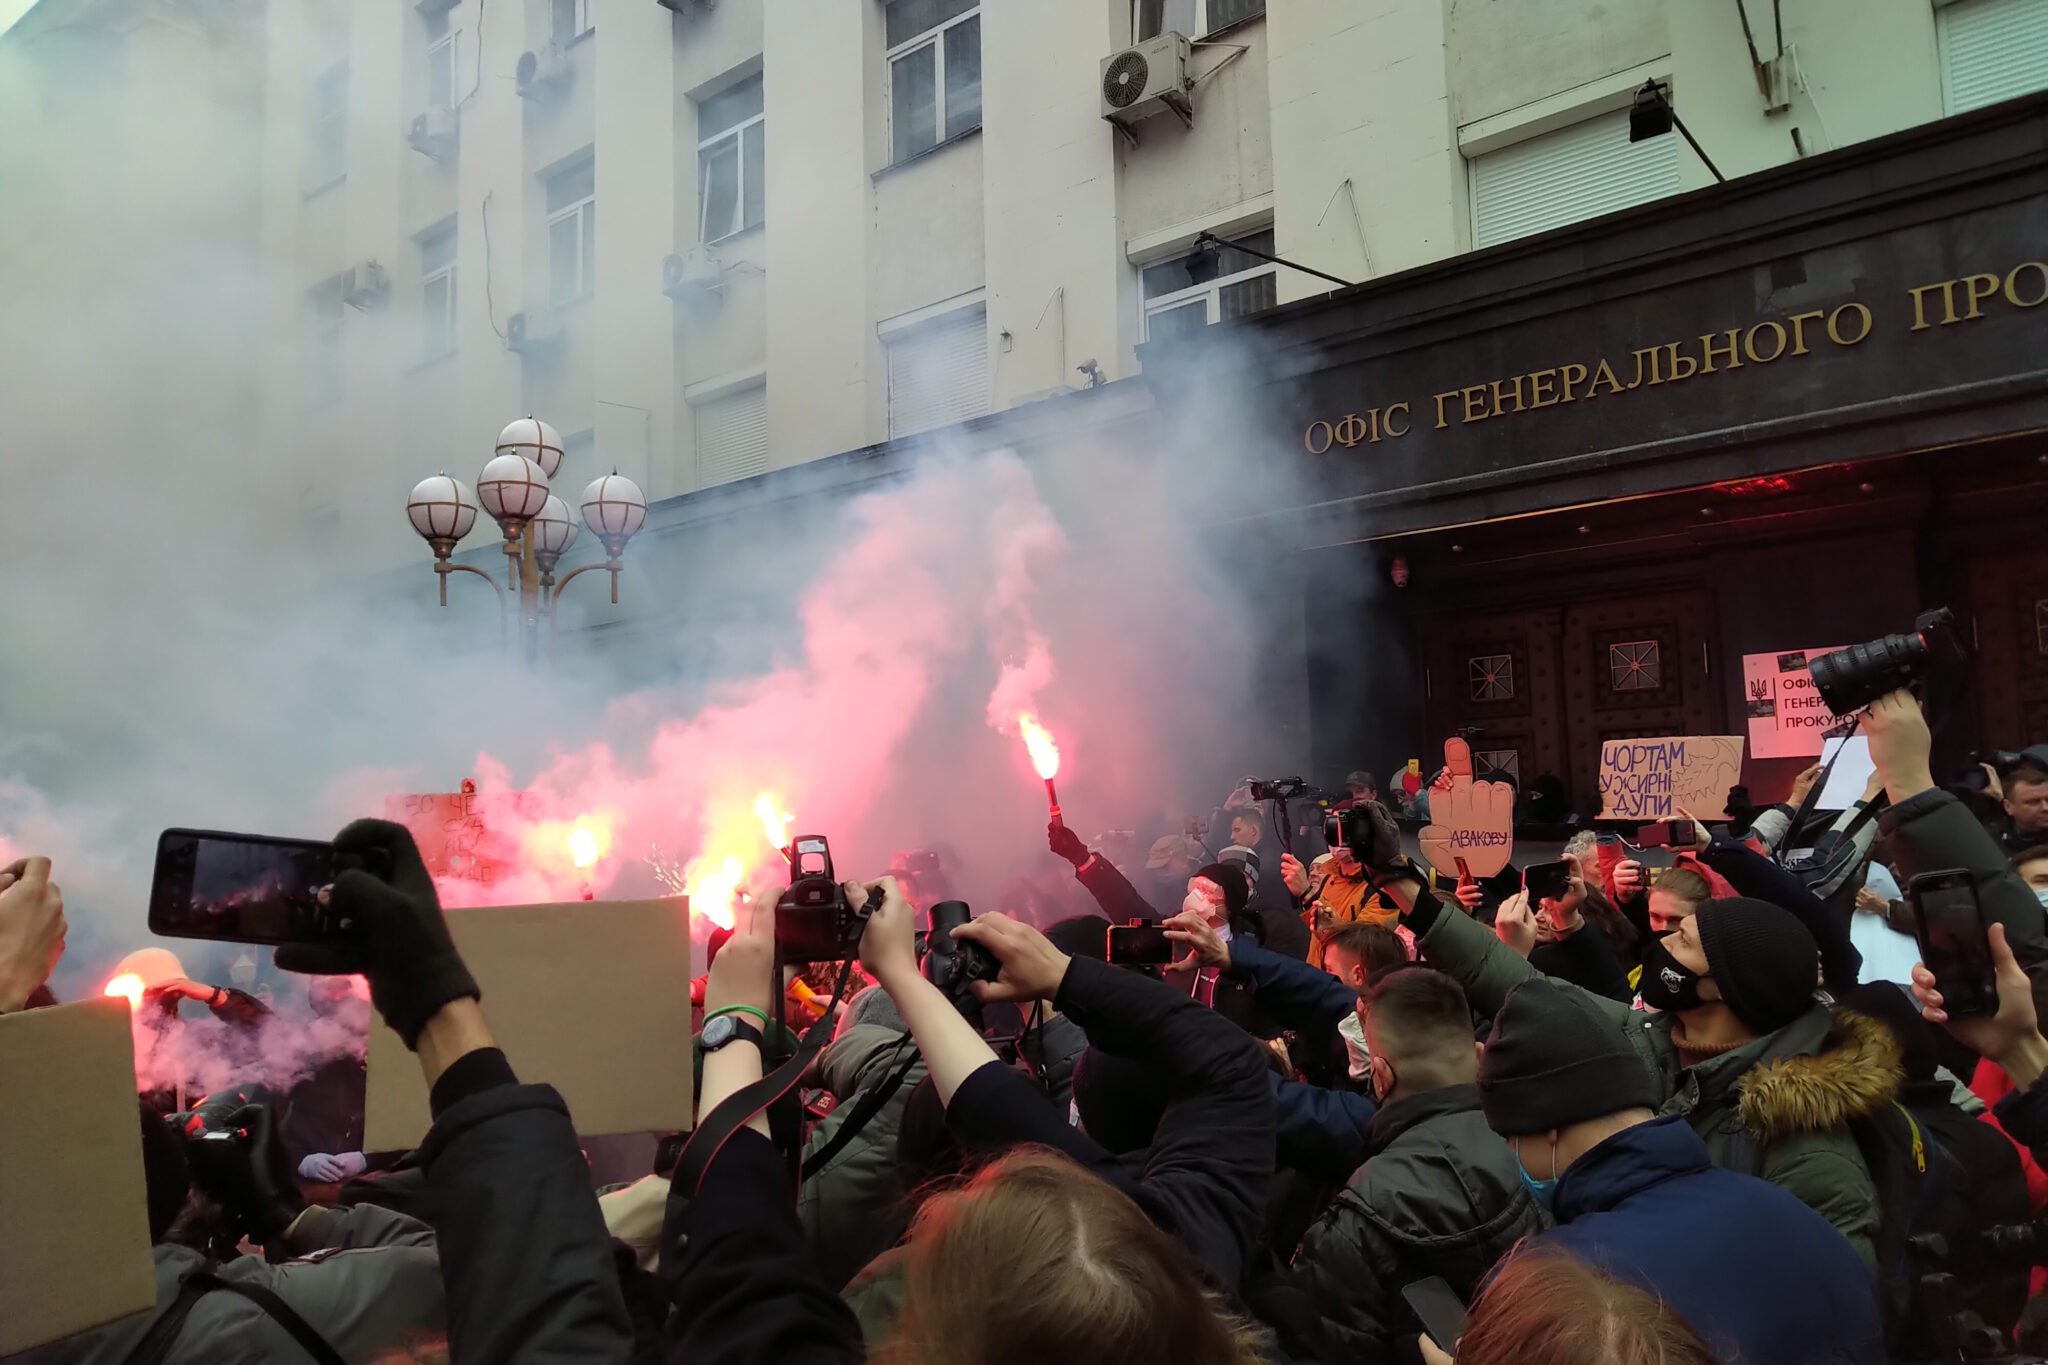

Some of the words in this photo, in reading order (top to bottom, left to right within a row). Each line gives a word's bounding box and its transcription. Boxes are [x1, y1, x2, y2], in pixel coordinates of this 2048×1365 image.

[1304, 401, 1411, 455] ОФІС
[1432, 302, 1873, 430] ГЕНЕРАЛЬНОГО
[1785, 713, 1858, 729] ПРОКУРО
[1604, 741, 1685, 773] ЧОРТАМ
[1613, 794, 1672, 817] ДУПИ
[1450, 829, 1508, 849] АВАКОВУ
